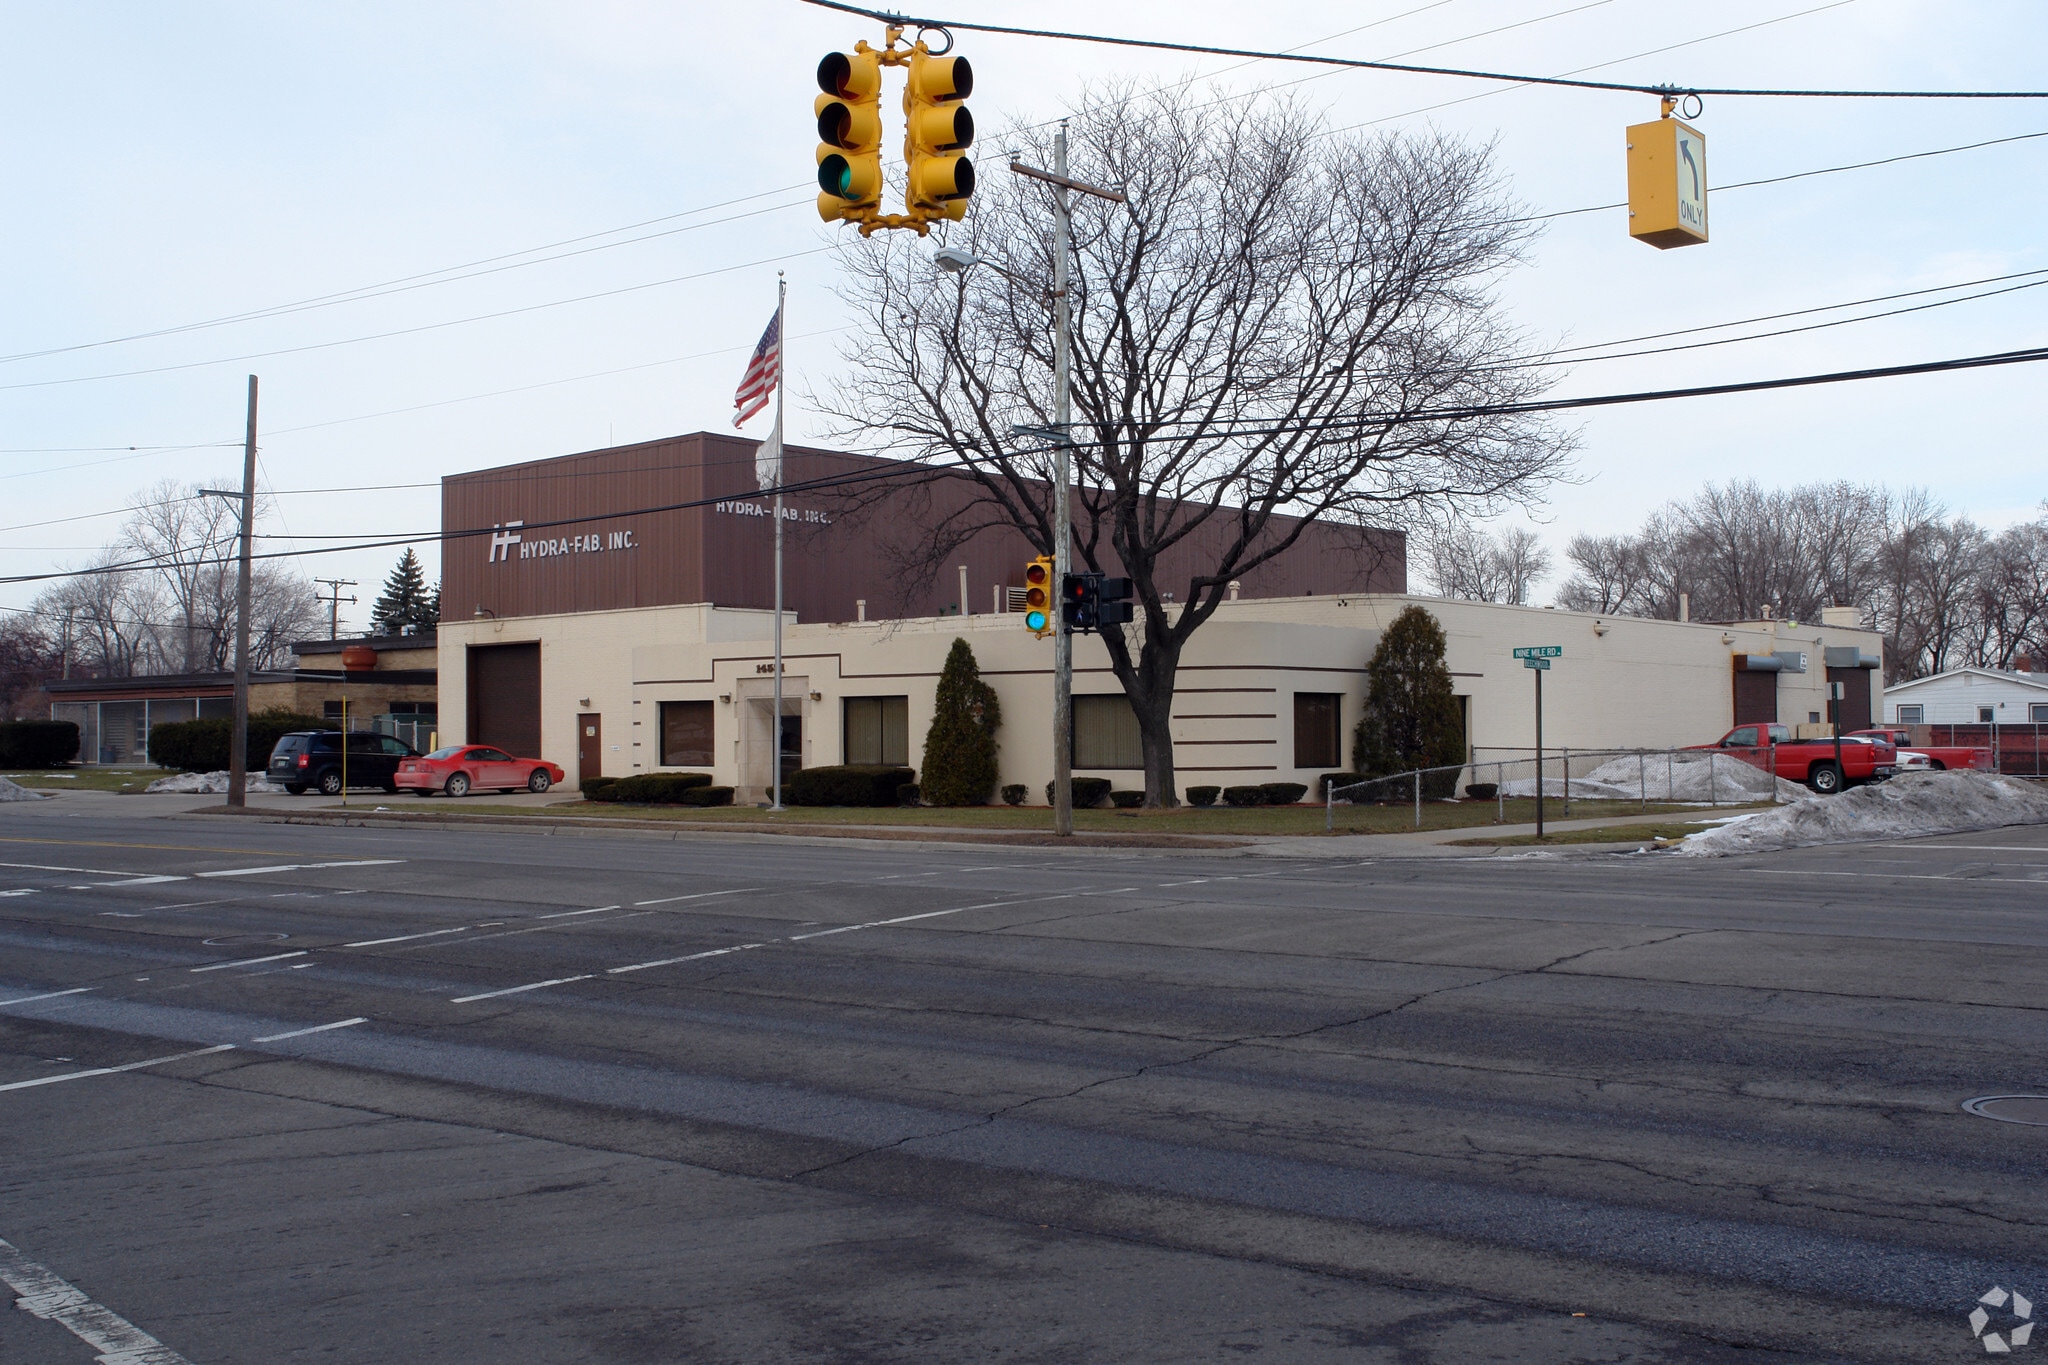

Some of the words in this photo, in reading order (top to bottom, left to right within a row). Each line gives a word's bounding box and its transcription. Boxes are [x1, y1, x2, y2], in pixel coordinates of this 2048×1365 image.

[1681, 200, 1703, 226] ONLY
[520, 534, 604, 559] HYDRA-FAB.
[608, 530, 640, 550] INC.
[1515, 648, 1530, 658] NINE
[1531, 648, 1546, 657] MILE
[1547, 647, 1556, 656] RD
[756, 663, 785, 673] 1451
